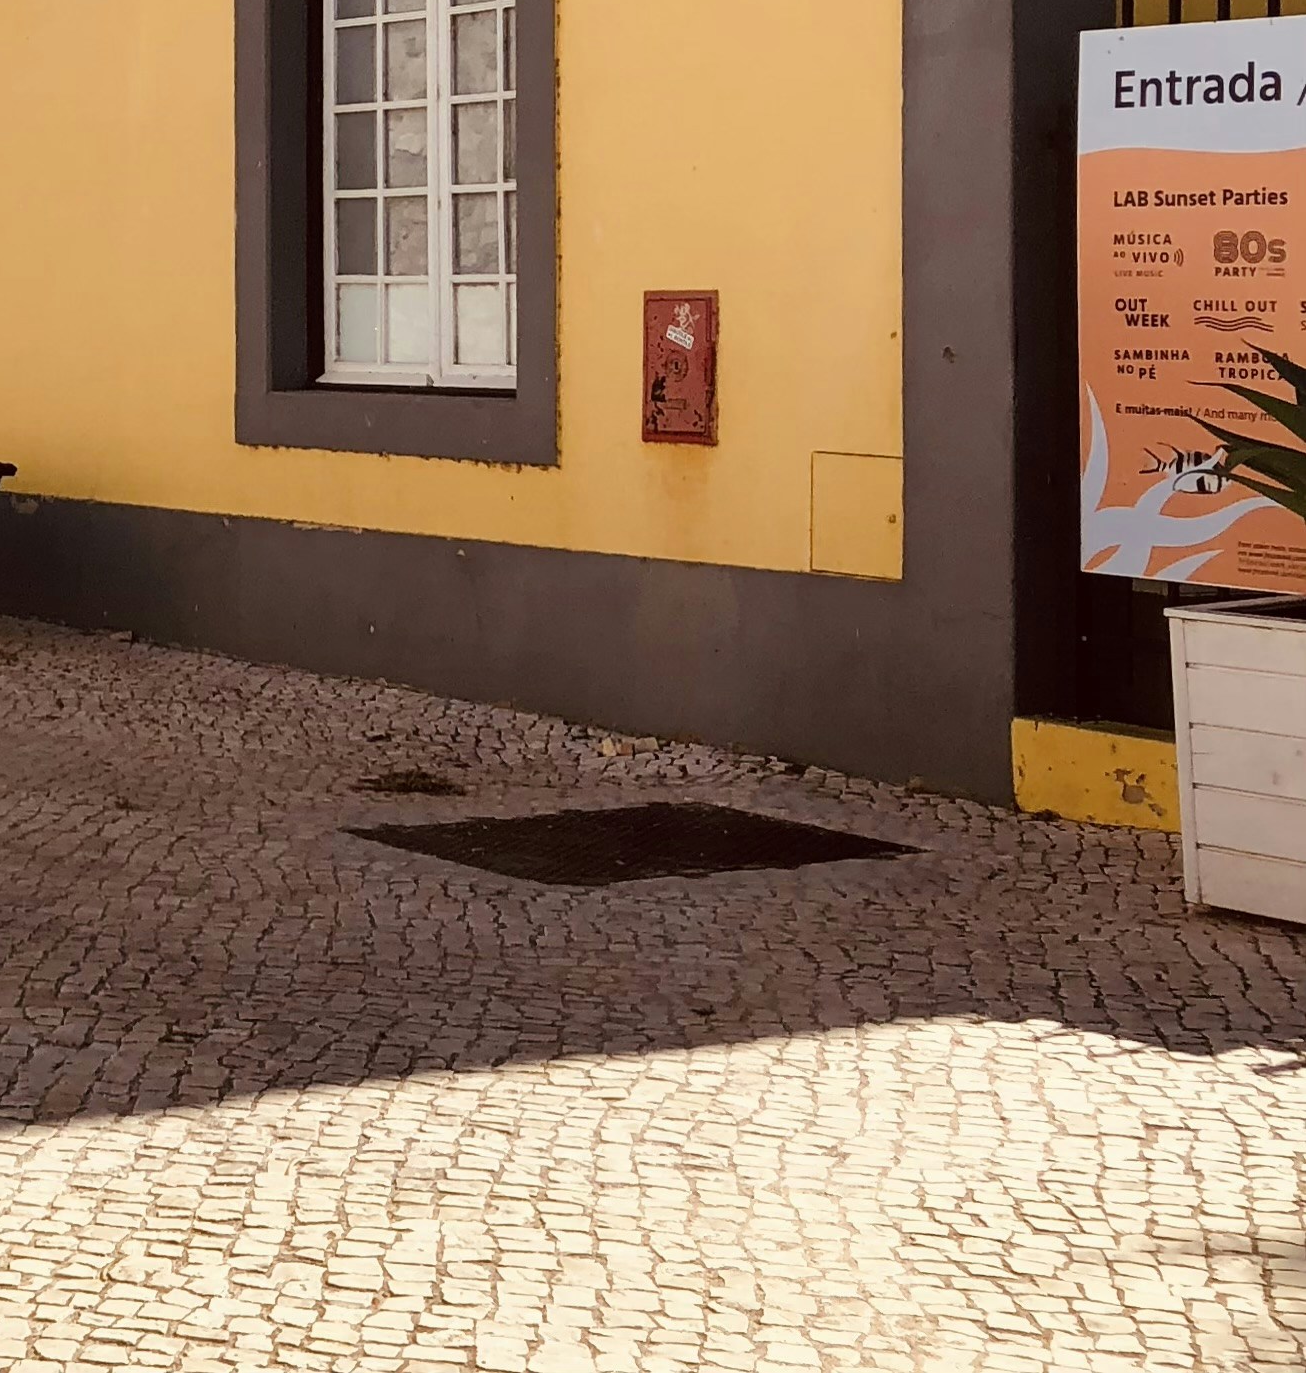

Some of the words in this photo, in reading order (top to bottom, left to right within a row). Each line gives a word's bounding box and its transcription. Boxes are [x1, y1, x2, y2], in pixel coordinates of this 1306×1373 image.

[1114, 61, 1282, 108] Entrada
[1113, 190, 1149, 207] LAB
[1153, 190, 1217, 207] Sunset
[1222, 187, 1289, 205] Parties
[1113, 230, 1172, 245] MÚSICA
[1213, 230, 1287, 264] 80s
[1132, 252, 1170, 263] VIVO
[1114, 270, 1133, 278] LIVE
[1136, 270, 1164, 278] MUSIC
[1214, 266, 1258, 278] PARTY
[1114, 298, 1148, 311] OUT
[1193, 299, 1238, 312] CHILL
[1245, 300, 1278, 313] OUT
[1125, 314, 1171, 327] WEEK
[1114, 349, 1190, 361] SAMBINHA
[1117, 365, 1134, 375] NO
[1139, 363, 1157, 379] PÉ
[1116, 403, 1122, 414] E
[1203, 408, 1225, 419] And
[1228, 410, 1256, 422] many
